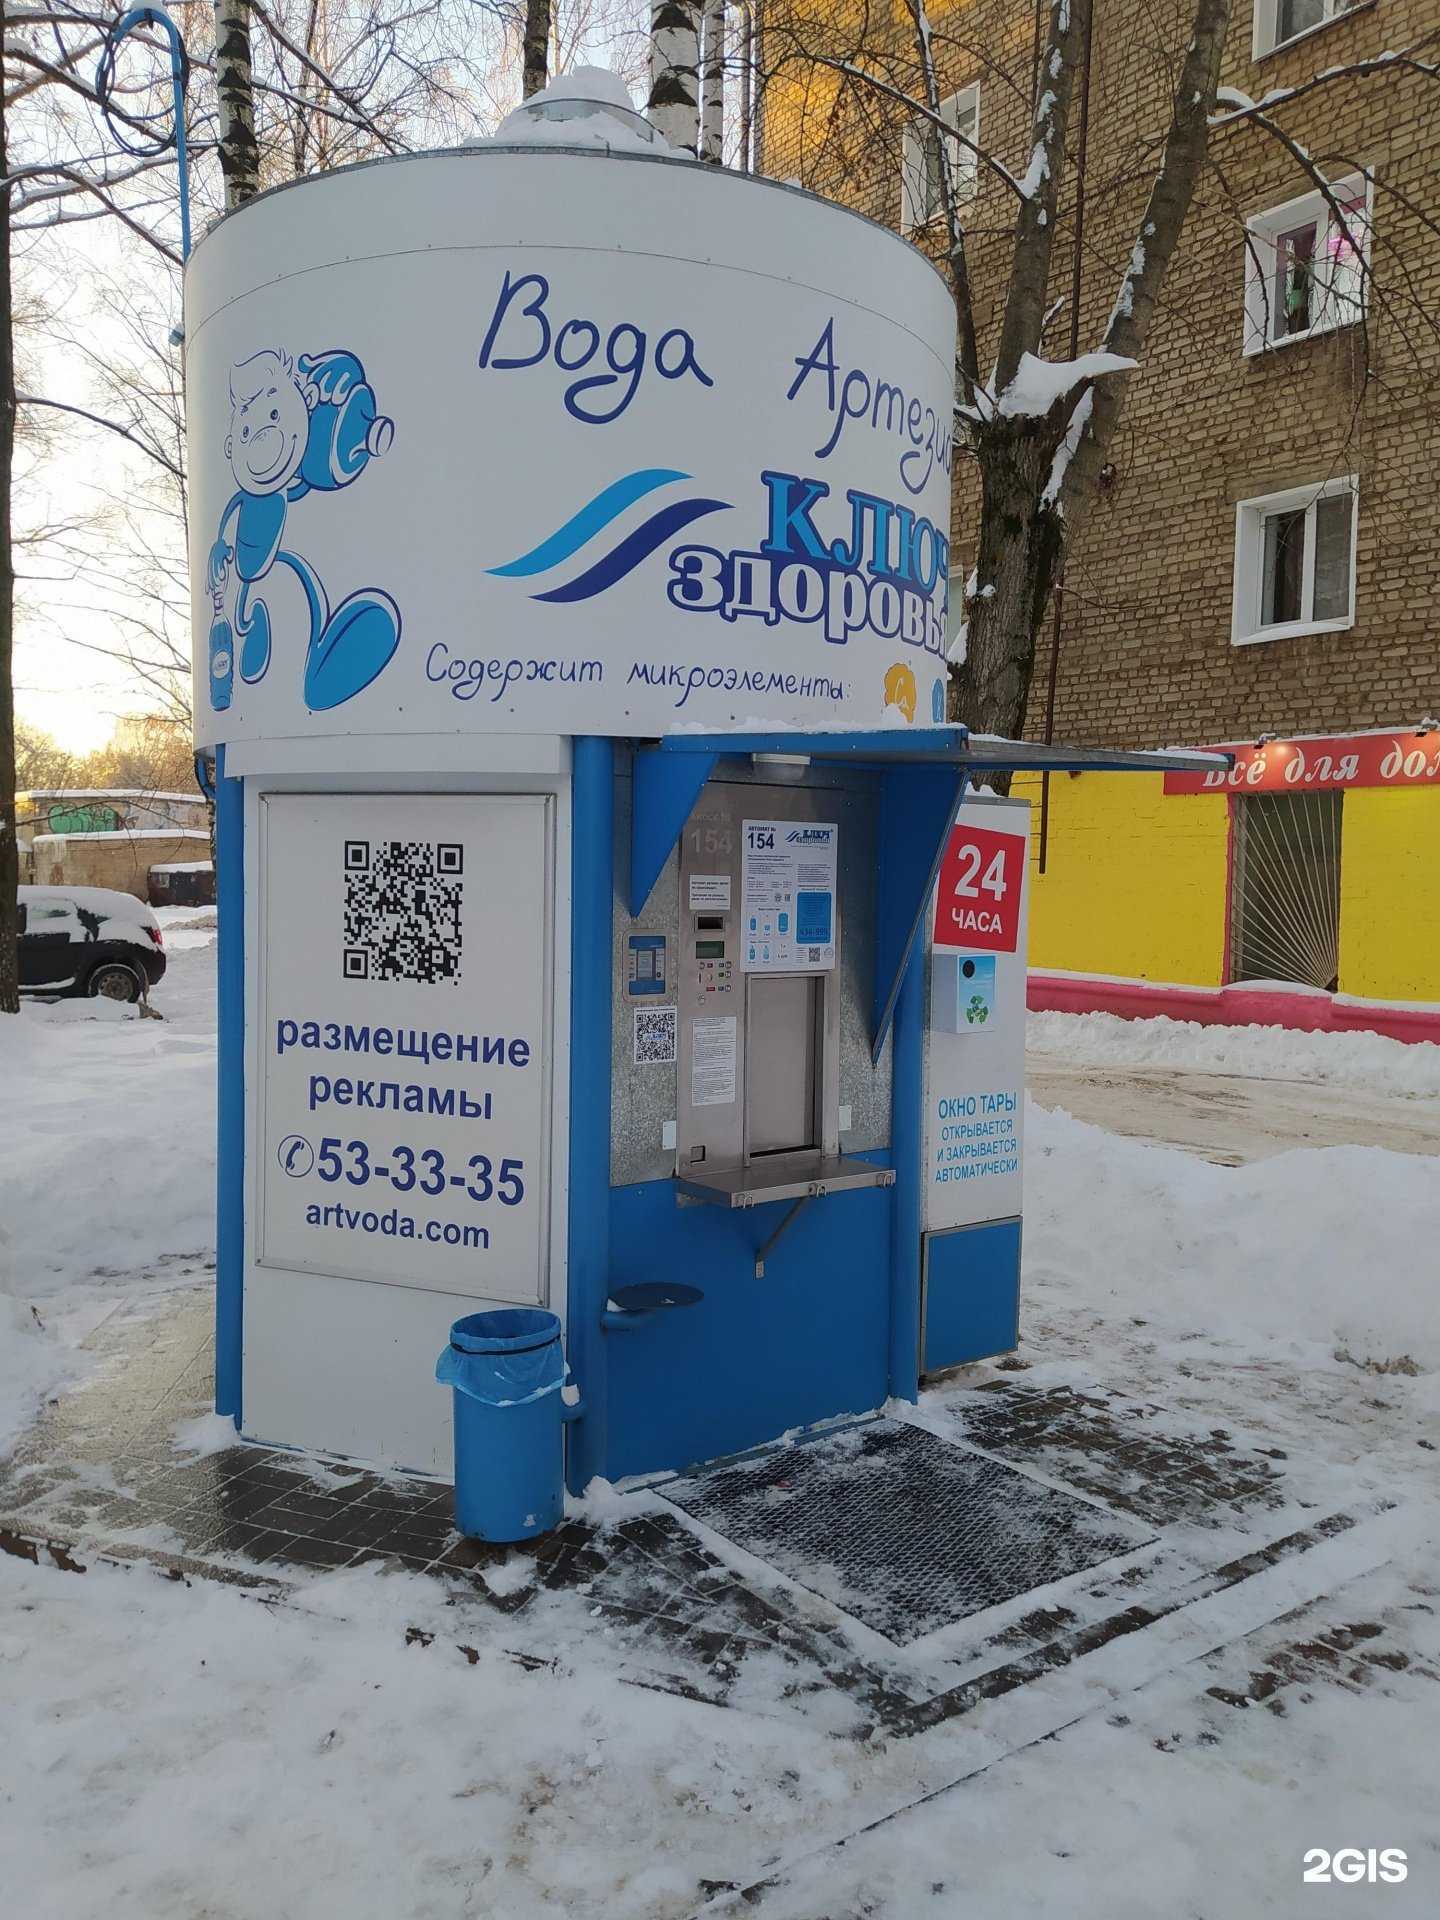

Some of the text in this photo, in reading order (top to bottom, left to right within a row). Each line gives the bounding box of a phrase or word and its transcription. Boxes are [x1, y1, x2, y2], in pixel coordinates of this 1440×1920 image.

[479, 270, 713, 424] Вода
[426, 642, 851, 708] Содержит микроэлементы:
[1284, 747, 1360, 784] для
[747, 832, 775, 850] 154
[955, 844, 1007, 902] 24
[951, 907, 1003, 934] ЧАСА
[276, 1016, 531, 1067] размещение
[308, 1074, 492, 1120] рекламы
[938, 1091, 1017, 1119] ОКНО ТАРЫ
[937, 1138, 1017, 1162] И ЗАКРЫВАЕТСЯ
[941, 1119, 1013, 1141] ОТКРЫВАЕТСЯ
[317, 1137, 525, 1206] 53-33-35
[935, 1157, 1019, 1183] АВТОМАТИЧЕСКИ
[305, 1201, 490, 1249] artvoda.com
